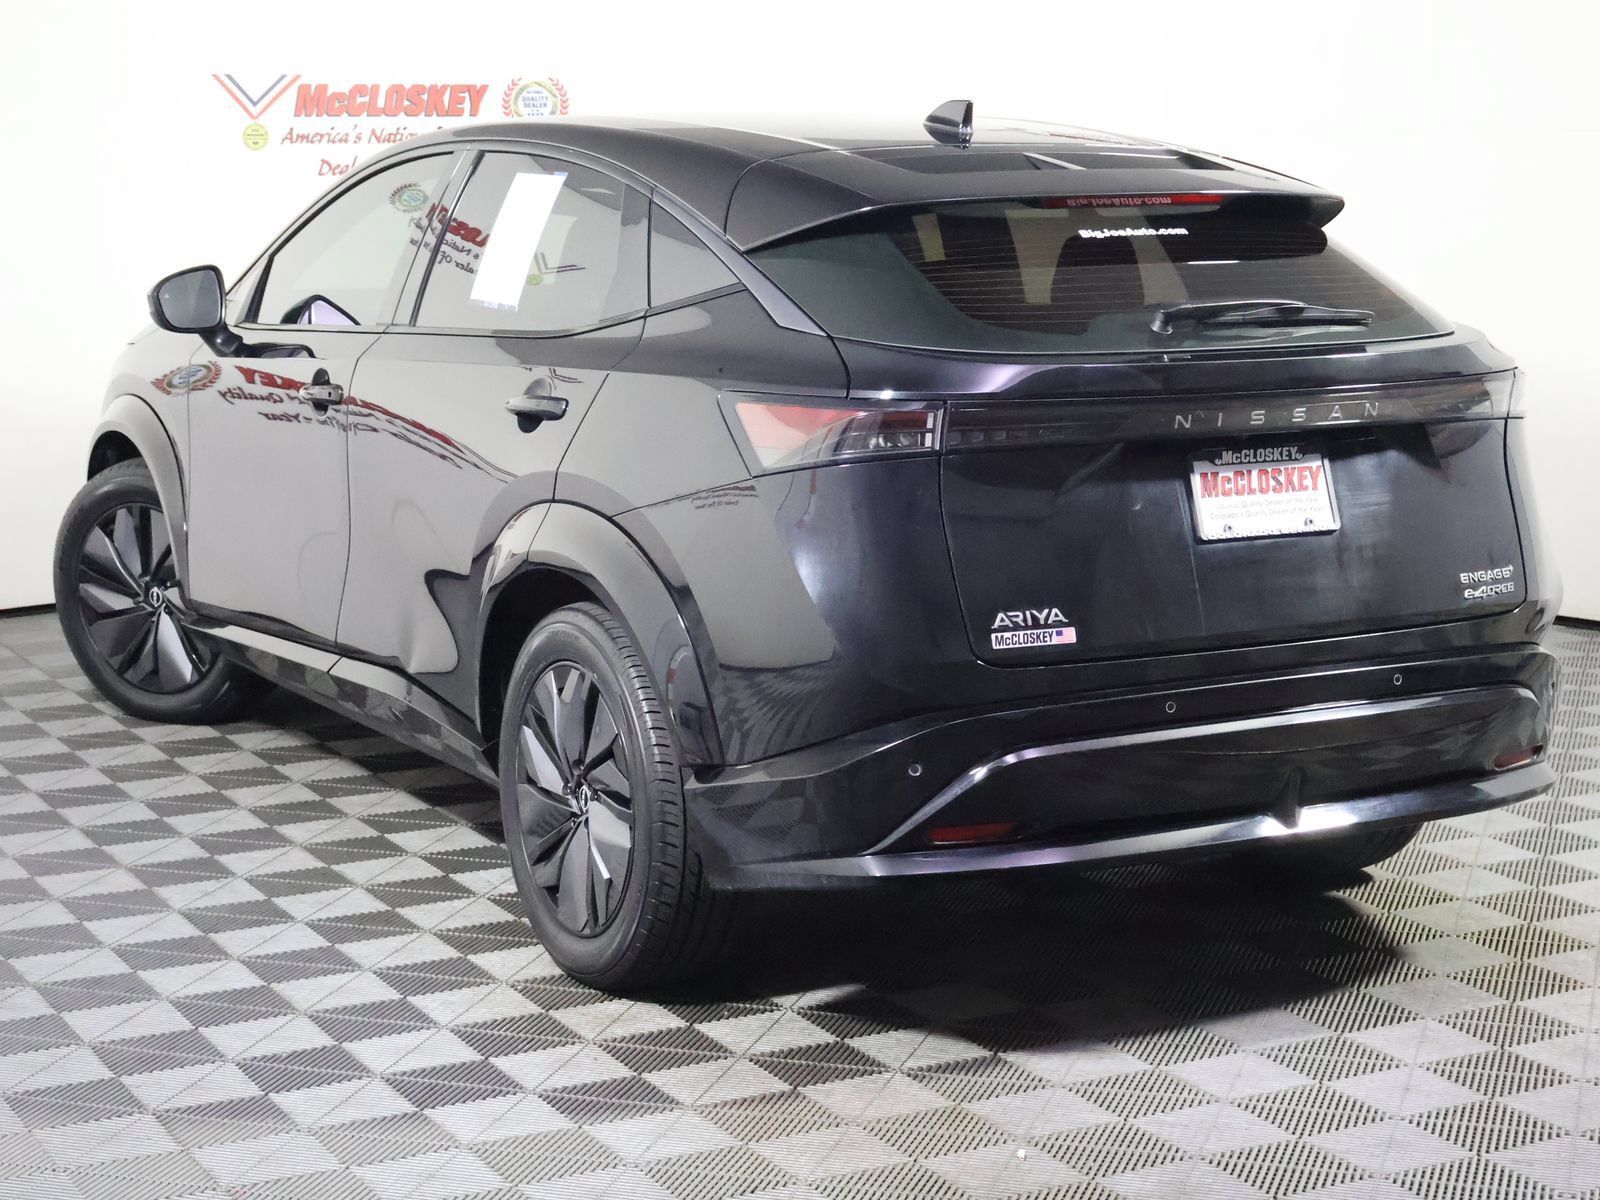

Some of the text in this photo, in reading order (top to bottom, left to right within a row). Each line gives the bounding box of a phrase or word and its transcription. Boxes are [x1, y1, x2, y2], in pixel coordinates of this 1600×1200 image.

[294, 84, 489, 117] McCLOSKEY
[280, 124, 363, 145] America's
[1078, 227, 1189, 239] BigJoeAuto.com
[1174, 403, 1379, 430] NISSAN
[1221, 446, 1299, 465] McCLOSKEY
[1200, 465, 1322, 499] McCLOSKEY
[991, 607, 1069, 629] ARIYA
[994, 630, 1054, 648] McCLOSKEY
